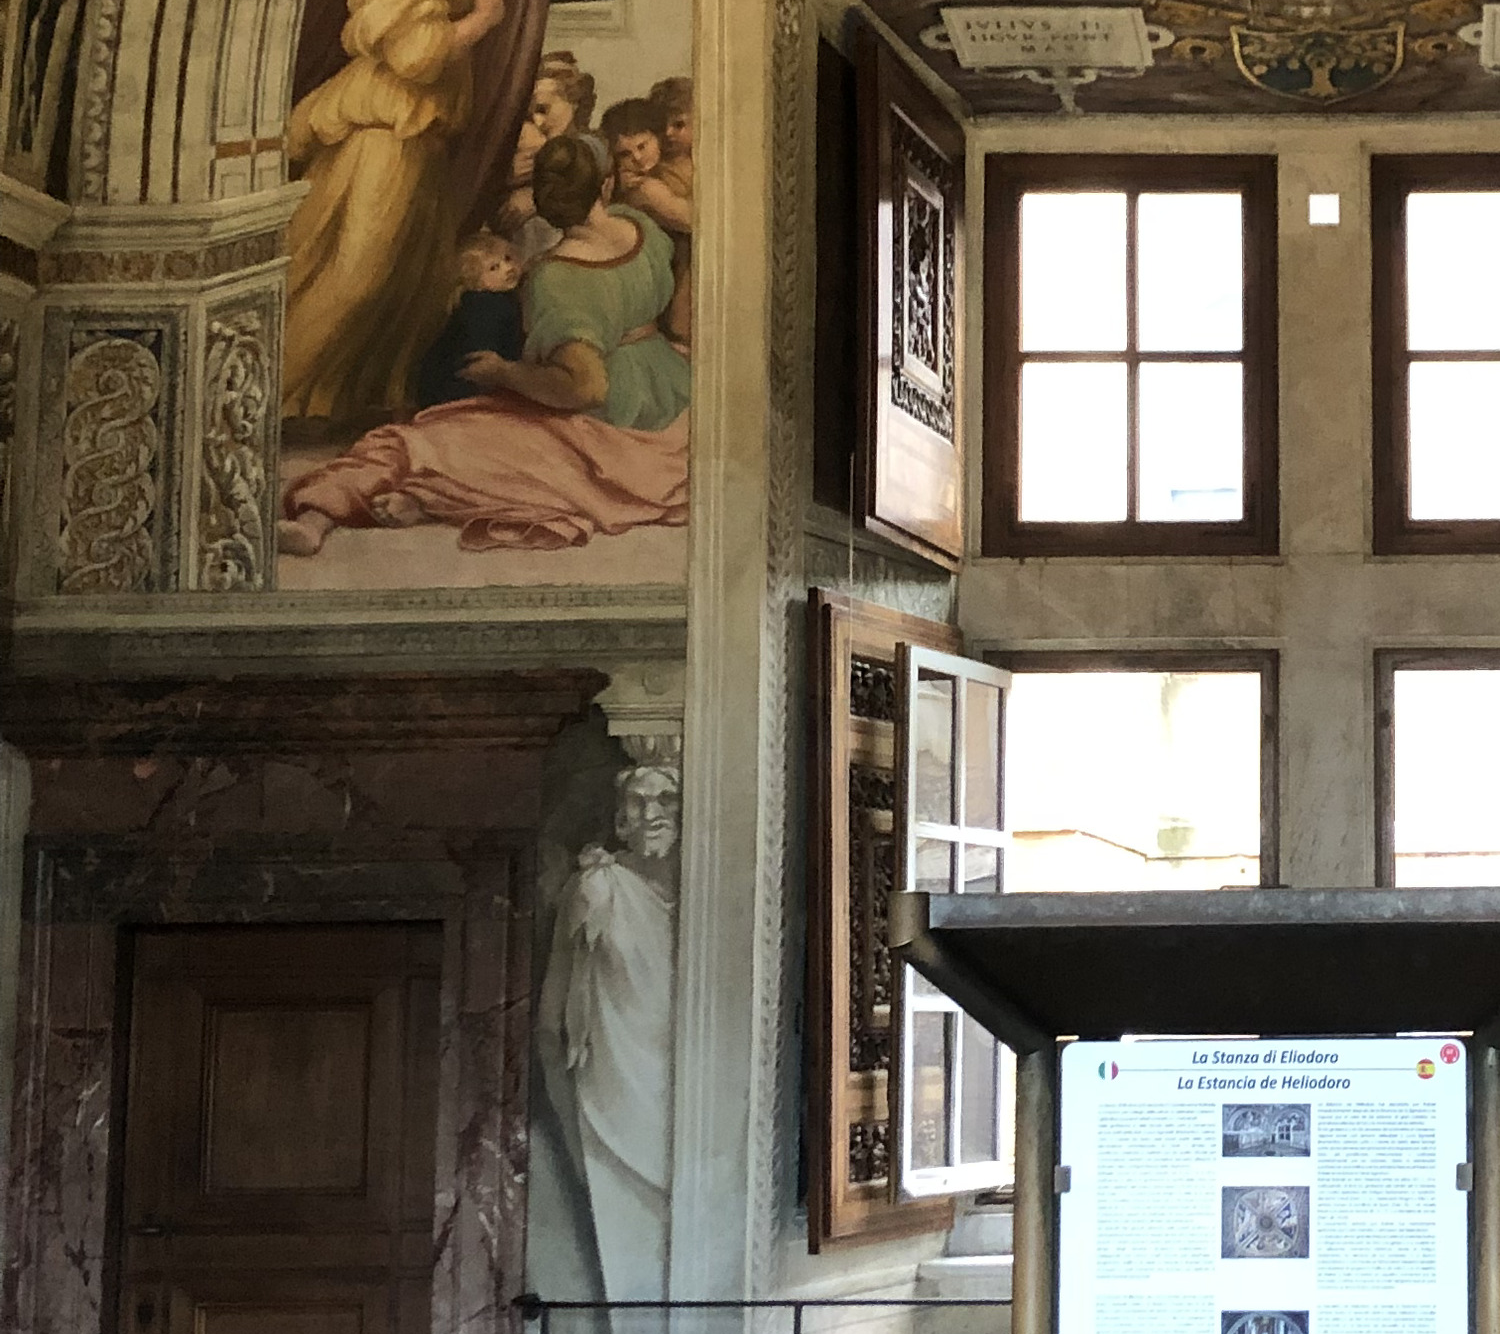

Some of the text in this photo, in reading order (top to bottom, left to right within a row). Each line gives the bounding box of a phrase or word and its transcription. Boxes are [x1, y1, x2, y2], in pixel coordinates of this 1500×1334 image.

[1191, 1049, 1339, 1065] La Stanza di Eliodoro
[1177, 1074, 1351, 1090] La Estancia de Heliodoro
